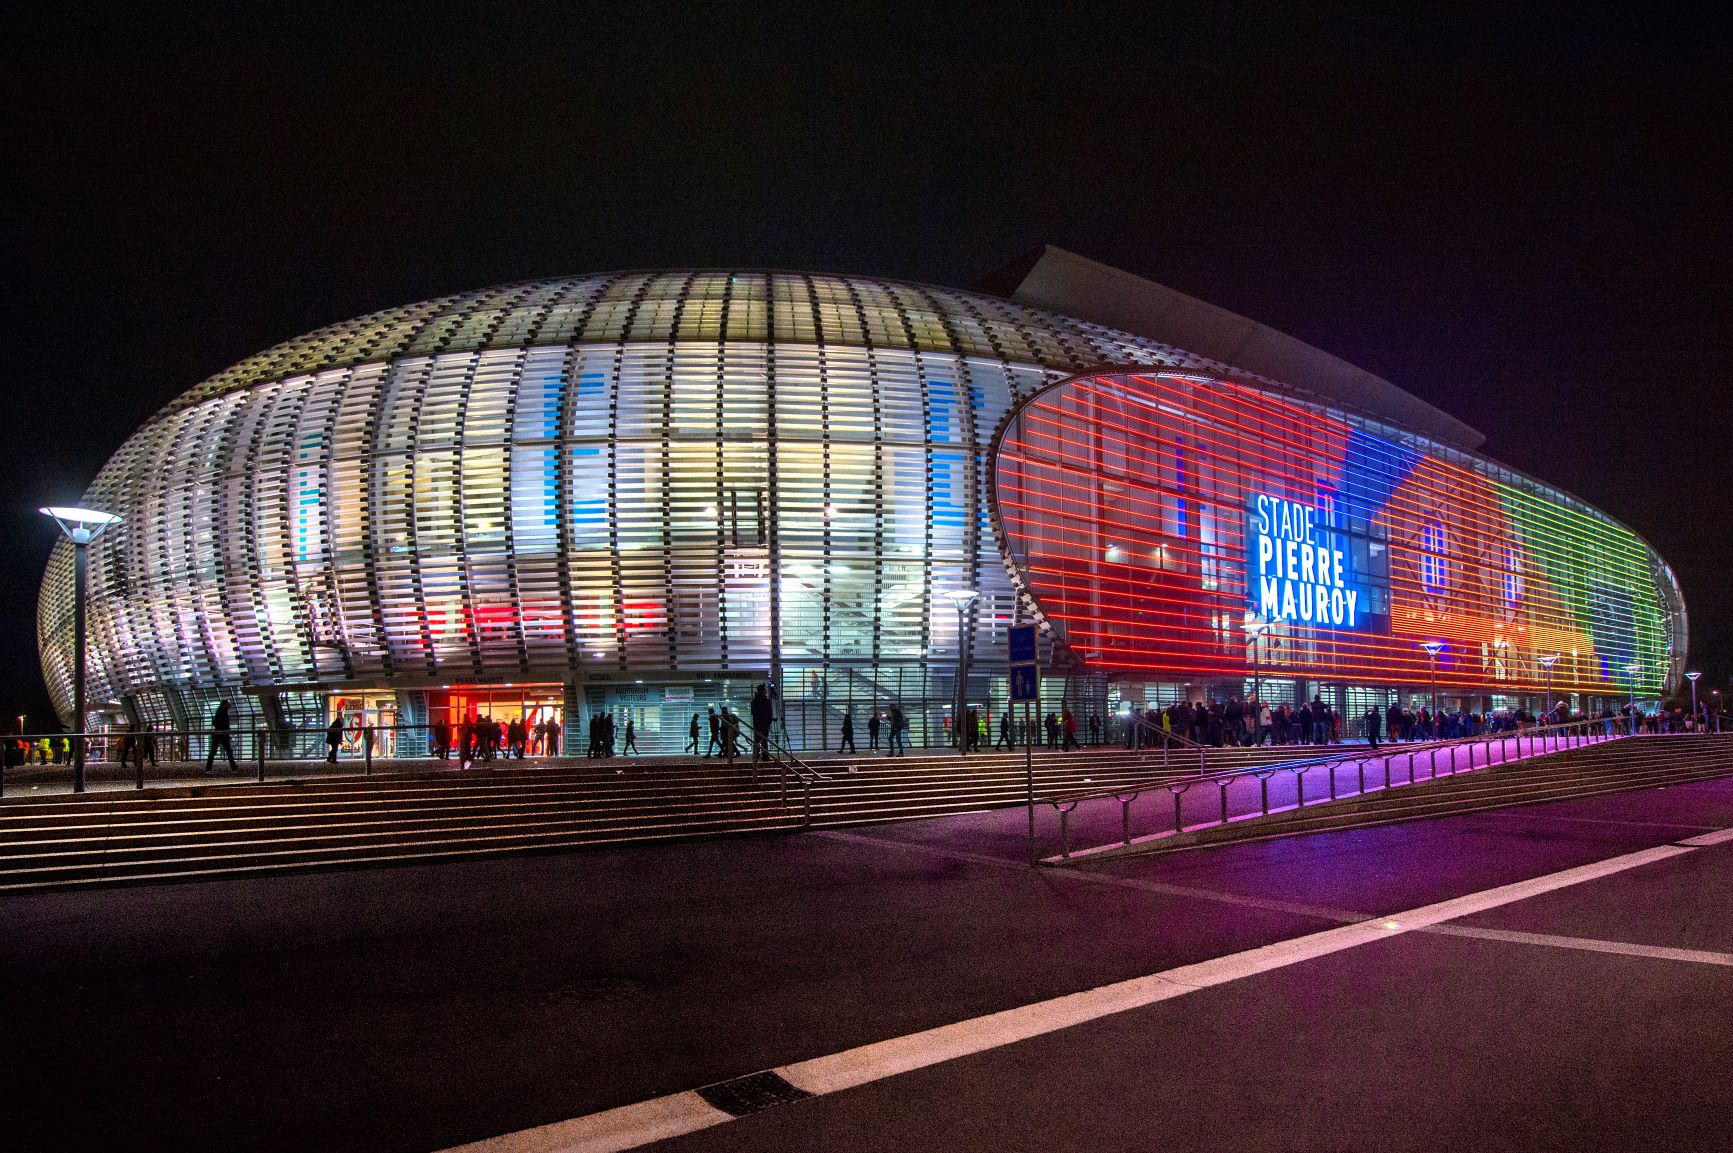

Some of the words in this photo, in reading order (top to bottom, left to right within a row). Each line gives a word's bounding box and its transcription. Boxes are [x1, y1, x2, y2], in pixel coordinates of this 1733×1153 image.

[1258, 494, 1315, 545] STADE
[1259, 535, 1344, 588] PIERRE
[1260, 576, 1357, 627] MAUROY
[616, 687, 648, 695] AUDITORIUM
[619, 694, 647, 702] VISITEURS
